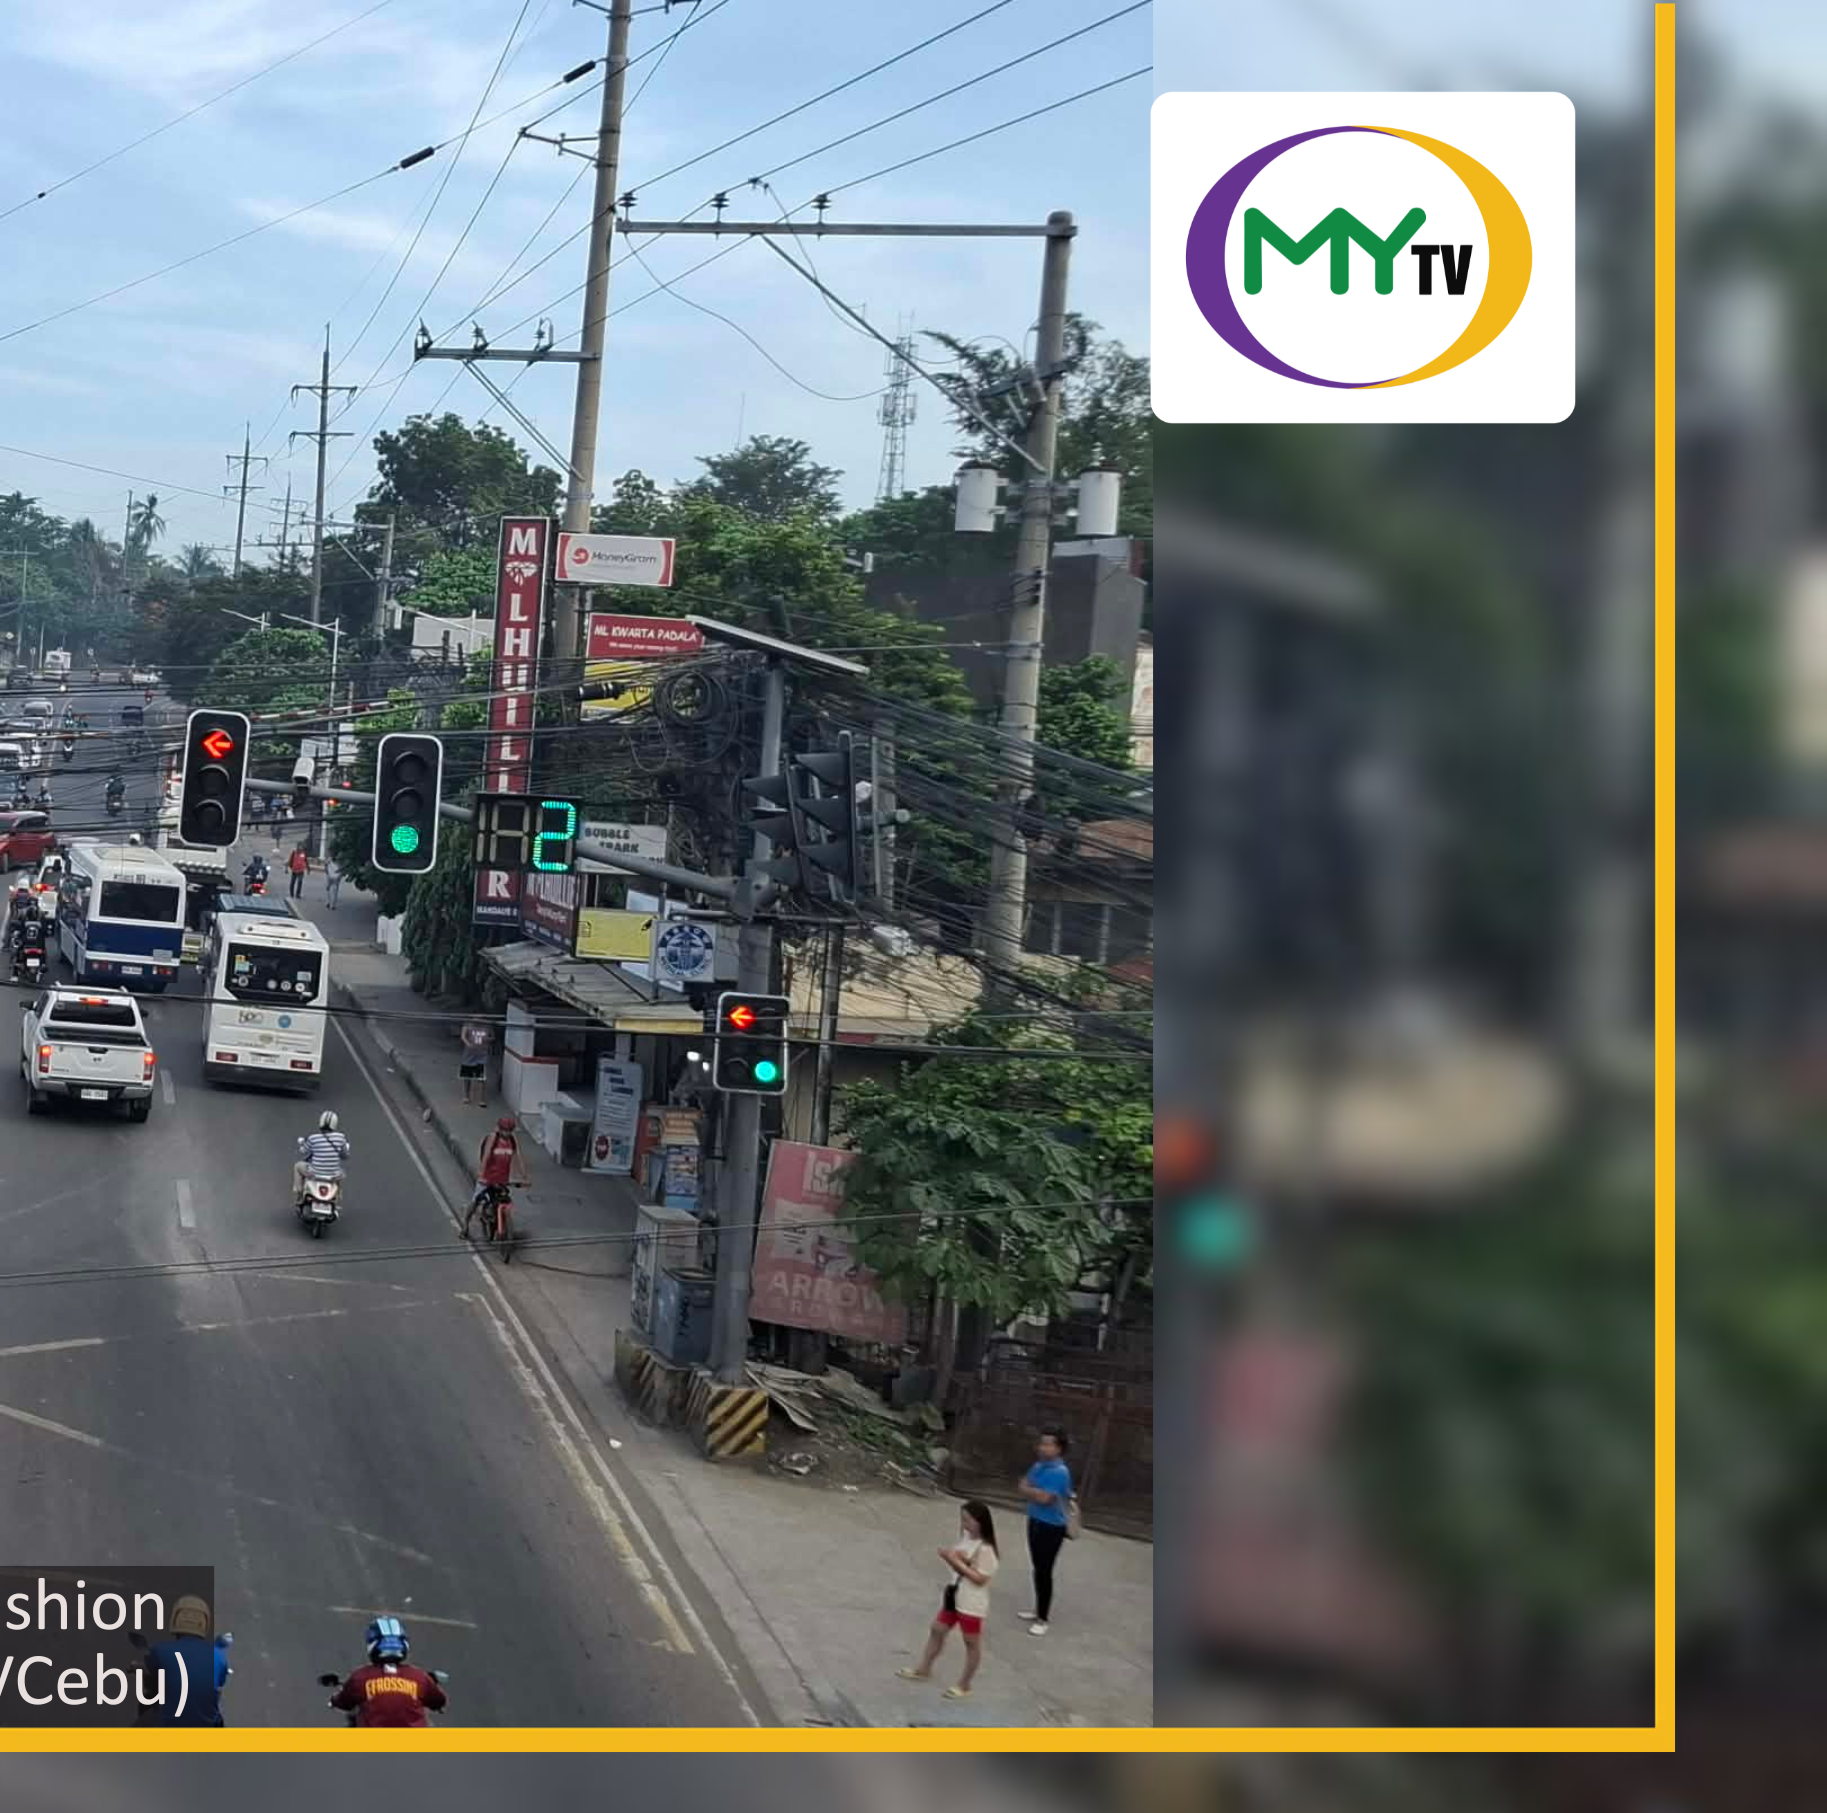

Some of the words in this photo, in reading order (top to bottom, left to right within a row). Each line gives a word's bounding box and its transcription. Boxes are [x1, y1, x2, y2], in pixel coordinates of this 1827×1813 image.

[591, 549, 658, 565] MoneyGram
[612, 626, 655, 639] KWARTA
[657, 630, 697, 642] PADALA
[584, 827, 631, 840] BUBBLE
